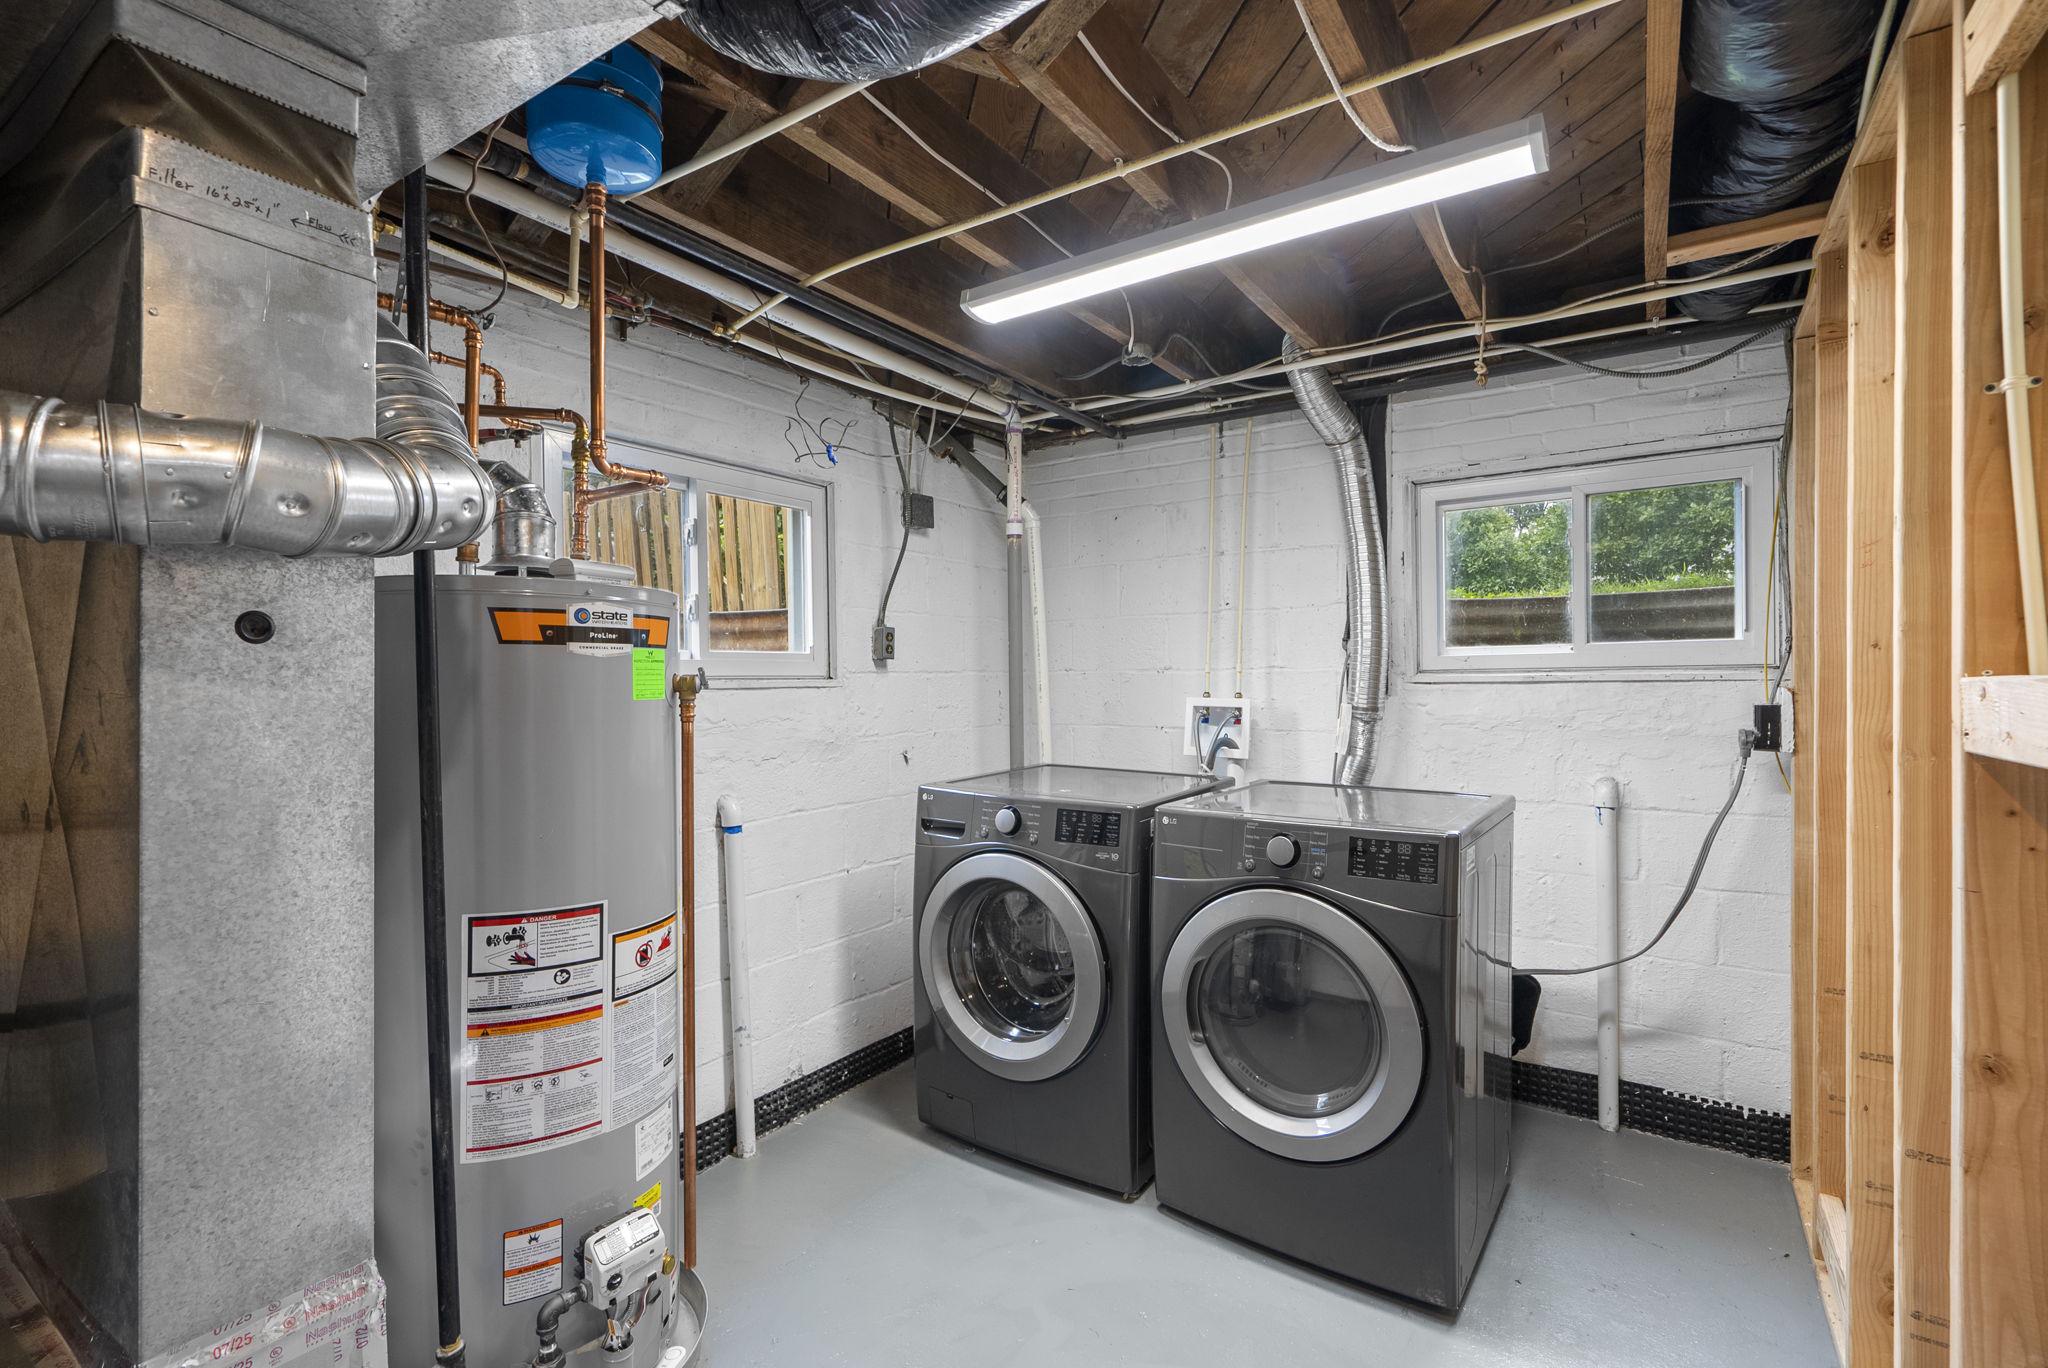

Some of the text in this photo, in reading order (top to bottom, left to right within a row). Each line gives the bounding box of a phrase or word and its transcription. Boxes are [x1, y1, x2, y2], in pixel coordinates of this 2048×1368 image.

[149, 167, 194, 192] Filter
[308, 217, 332, 232] Flow
[592, 611, 628, 621] state
[529, 914, 557, 923] DANGER
[303, 1264, 365, 1298] Nashua
[304, 1284, 368, 1321] Nashua
[305, 1306, 369, 1344] Nashua
[213, 1331, 254, 1360] 07/25
